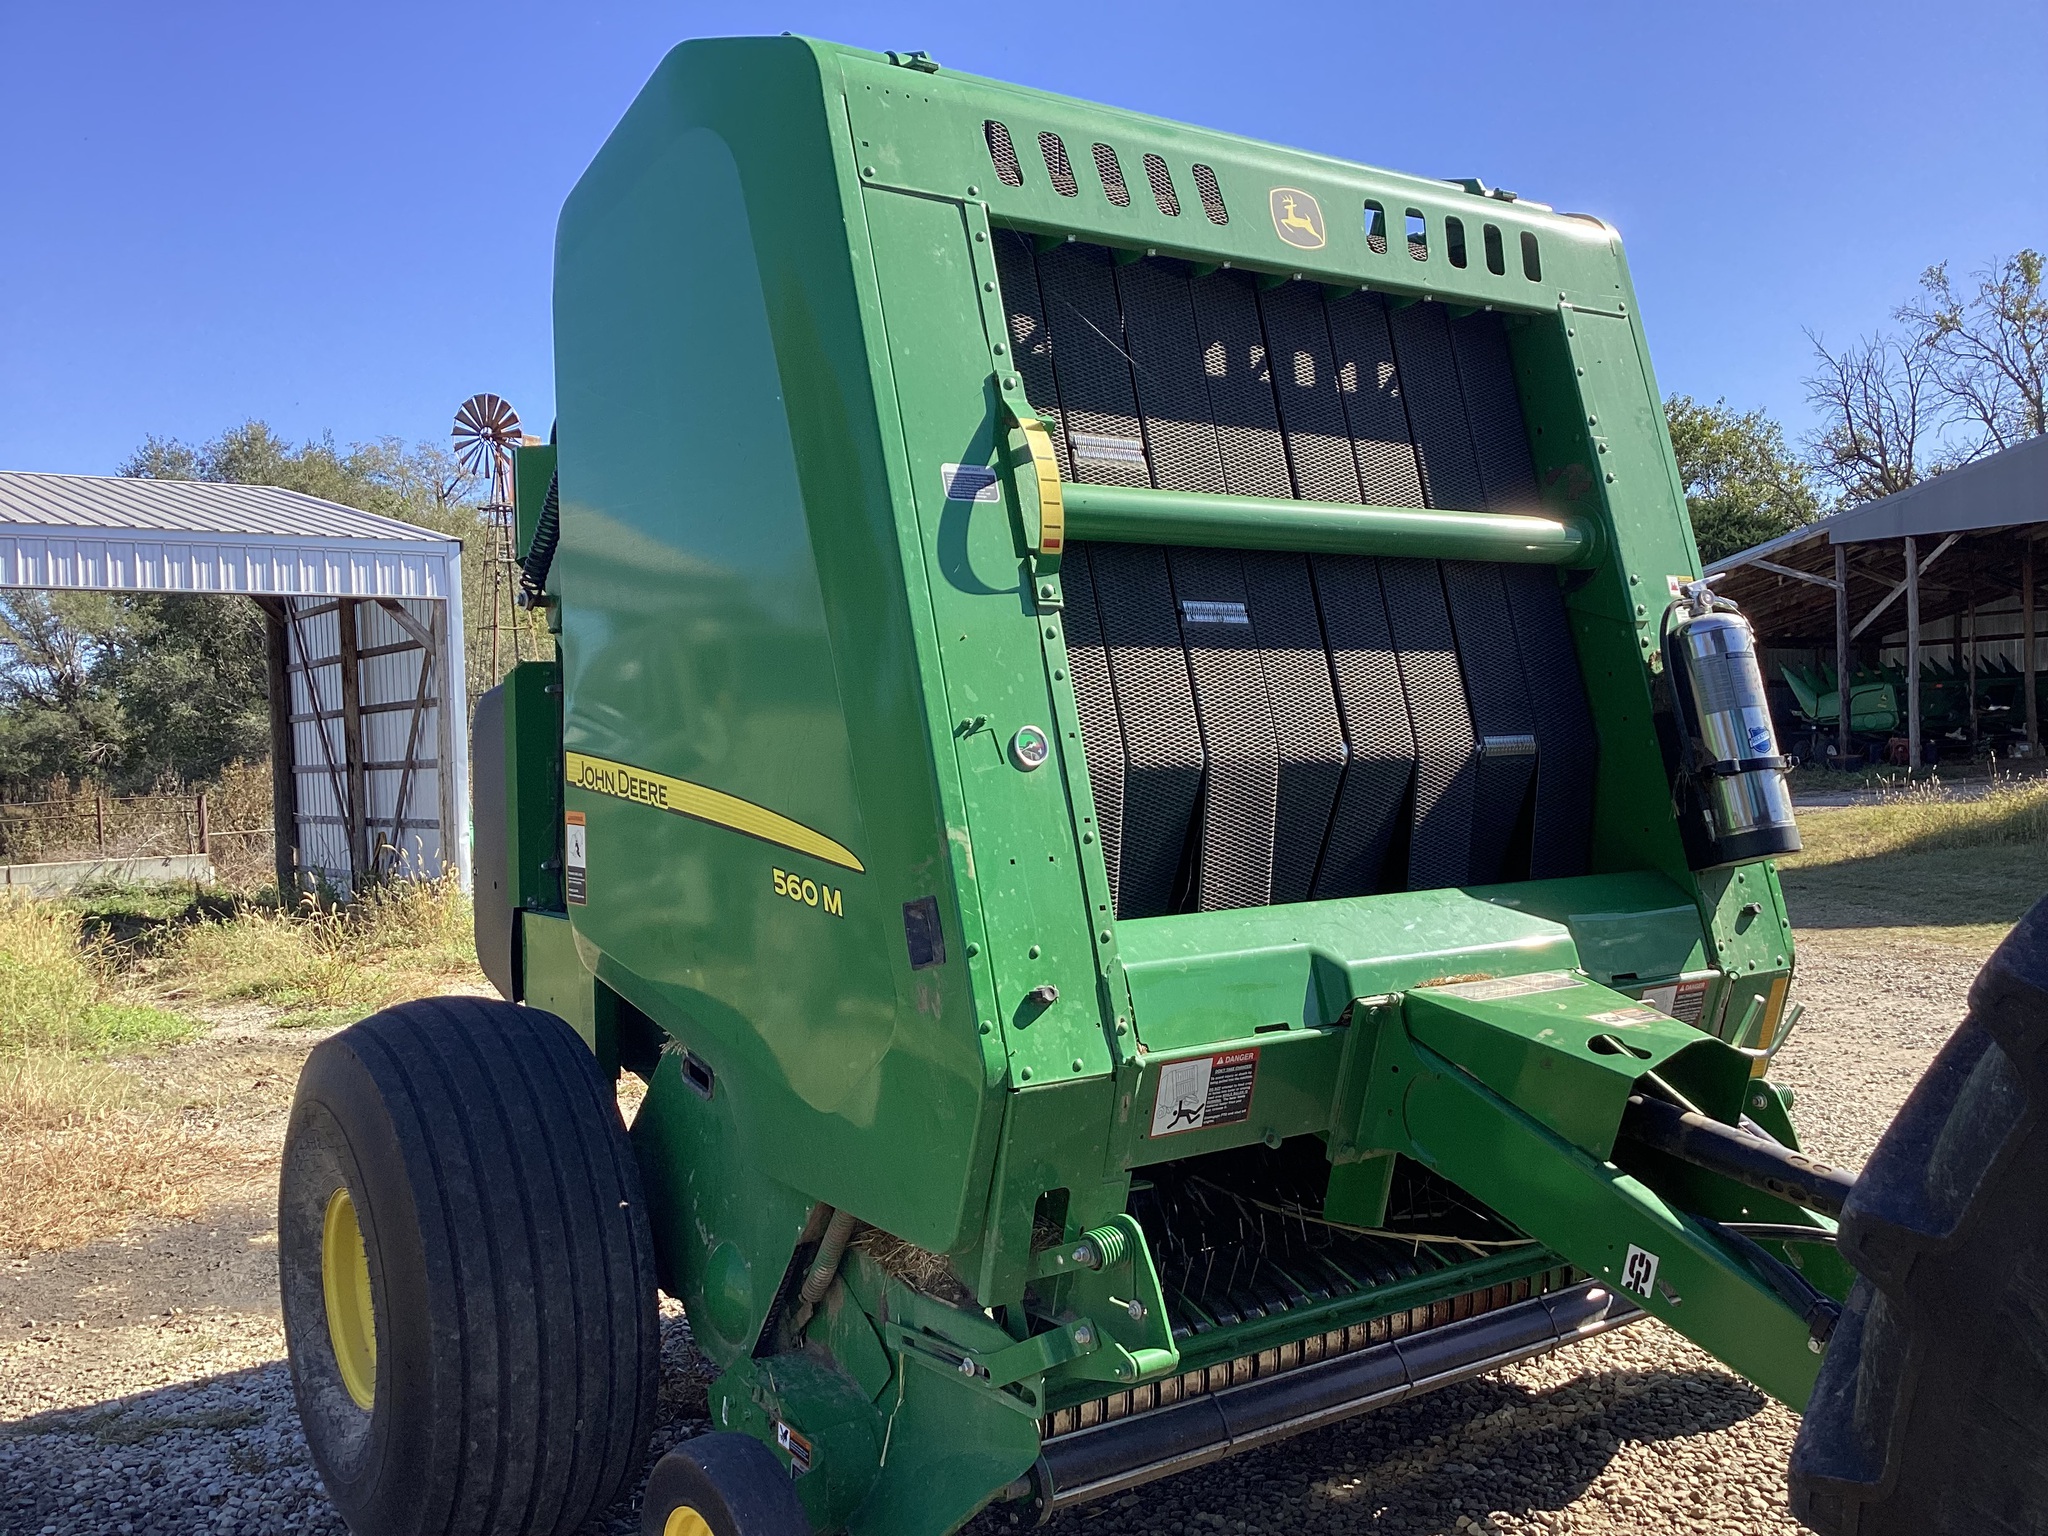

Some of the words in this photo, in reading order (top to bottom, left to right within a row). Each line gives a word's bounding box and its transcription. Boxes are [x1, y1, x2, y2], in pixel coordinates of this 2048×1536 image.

[577, 760, 616, 792] JOHN
[618, 769, 668, 807] DEERE
[772, 867, 819, 907] 560
[822, 884, 844, 918] M
[1684, 982, 1706, 991] DANGER
[1225, 1052, 1254, 1064] DANGER
